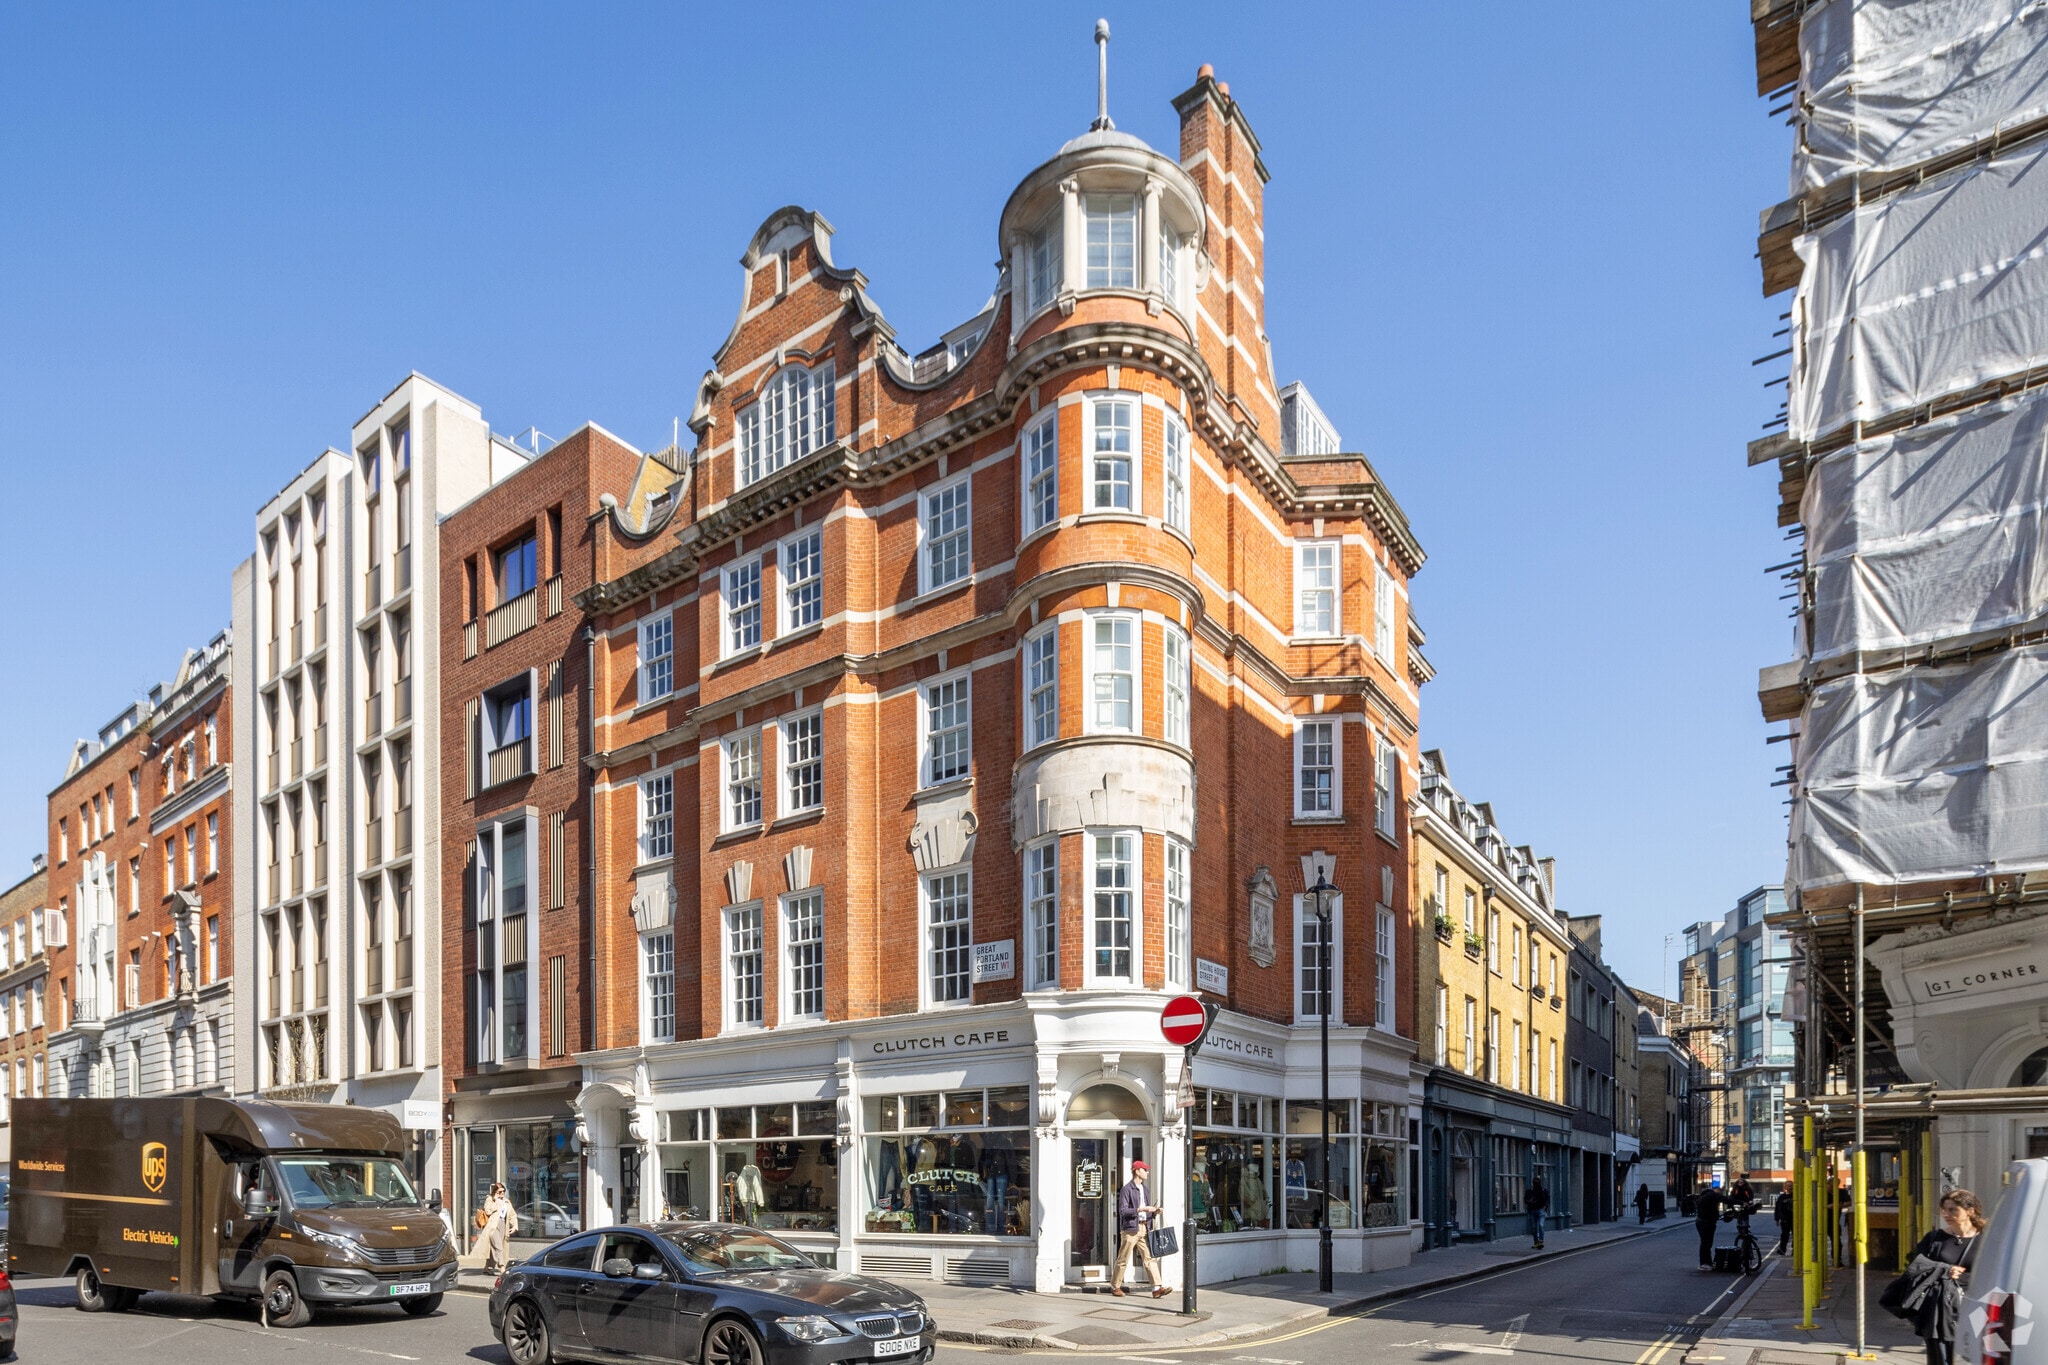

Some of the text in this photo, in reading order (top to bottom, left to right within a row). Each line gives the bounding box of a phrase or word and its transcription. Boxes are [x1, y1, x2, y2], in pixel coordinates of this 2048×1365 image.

[977, 945, 996, 955] GREAT
[977, 952, 1009, 964] PORTLAND
[977, 963, 999, 973] STREET
[1214, 966, 1226, 978] HOUSE
[1199, 971, 1213, 982] STREET
[1932, 965, 2038, 991] GT CORNER
[873, 1030, 1009, 1053] CLUTCH CAFE
[1204, 1035, 1273, 1058] LUTCH CAFE
[18, 1160, 65, 1172] Worldwide Services
[144, 1157, 165, 1184] ups
[907, 1168, 980, 1185] CLUTCH
[929, 1184, 958, 1192] CAFE
[123, 1228, 174, 1245] Electric Vehicle
